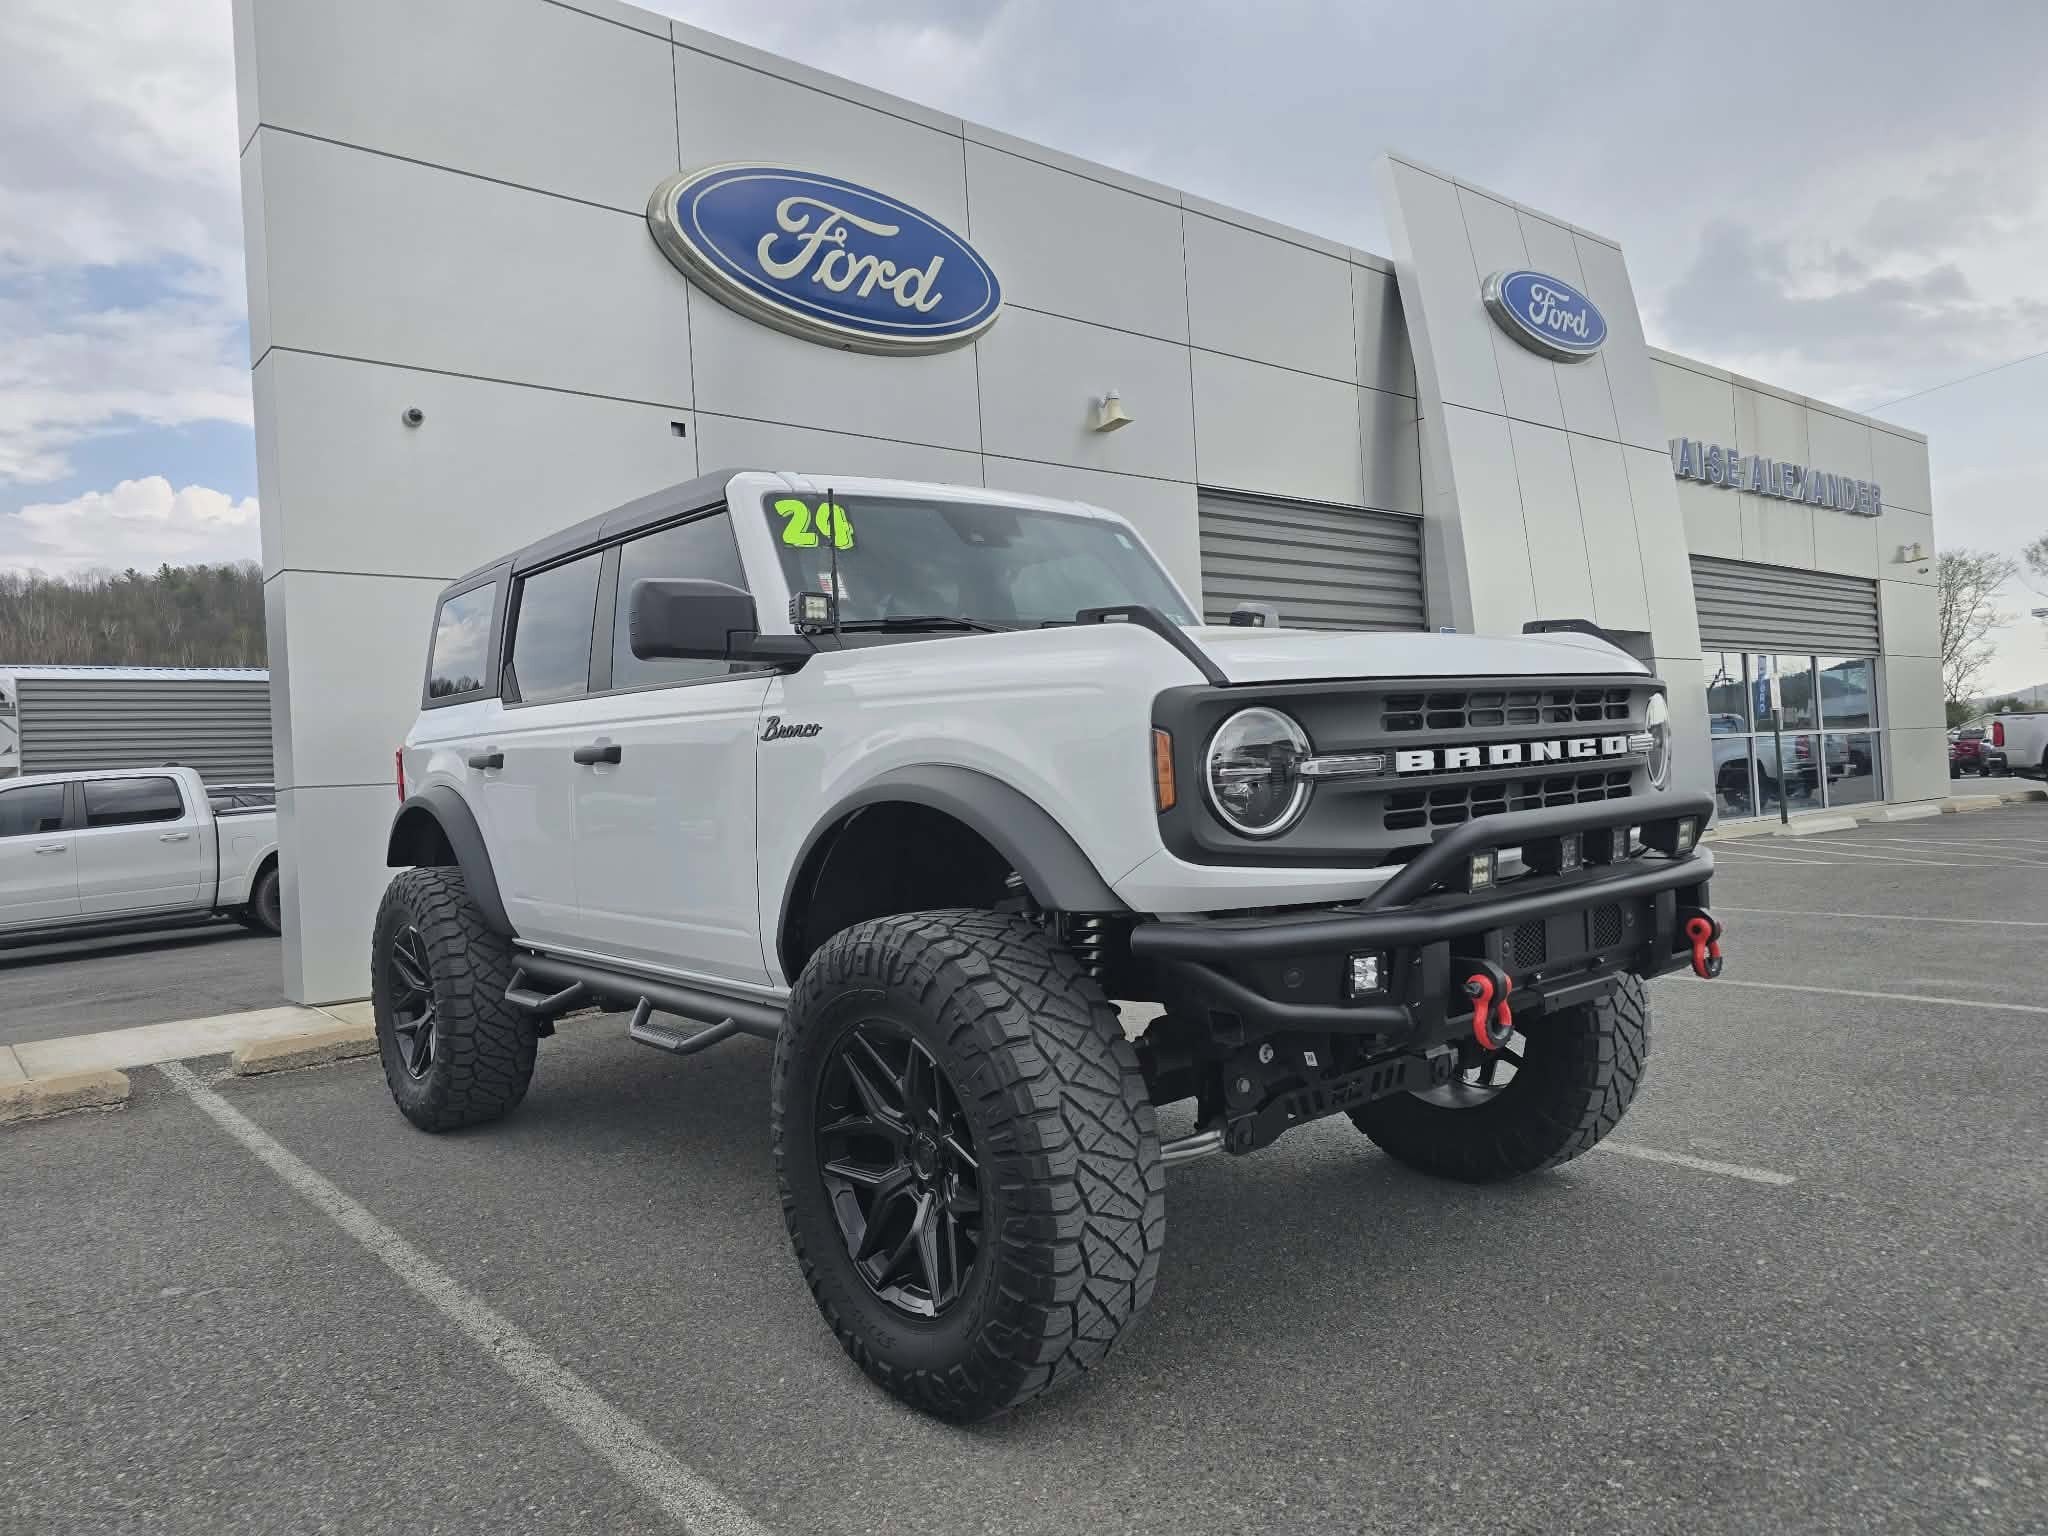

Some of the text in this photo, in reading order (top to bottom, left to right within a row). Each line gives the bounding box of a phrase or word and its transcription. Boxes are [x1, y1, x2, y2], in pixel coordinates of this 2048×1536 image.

[757, 196, 945, 313] Ford
[1529, 283, 1590, 338] Ford
[1670, 437, 1882, 516] AISE ALEXANDER
[760, 715, 823, 741] Bronco
[1395, 735, 1627, 772] BRONCO
